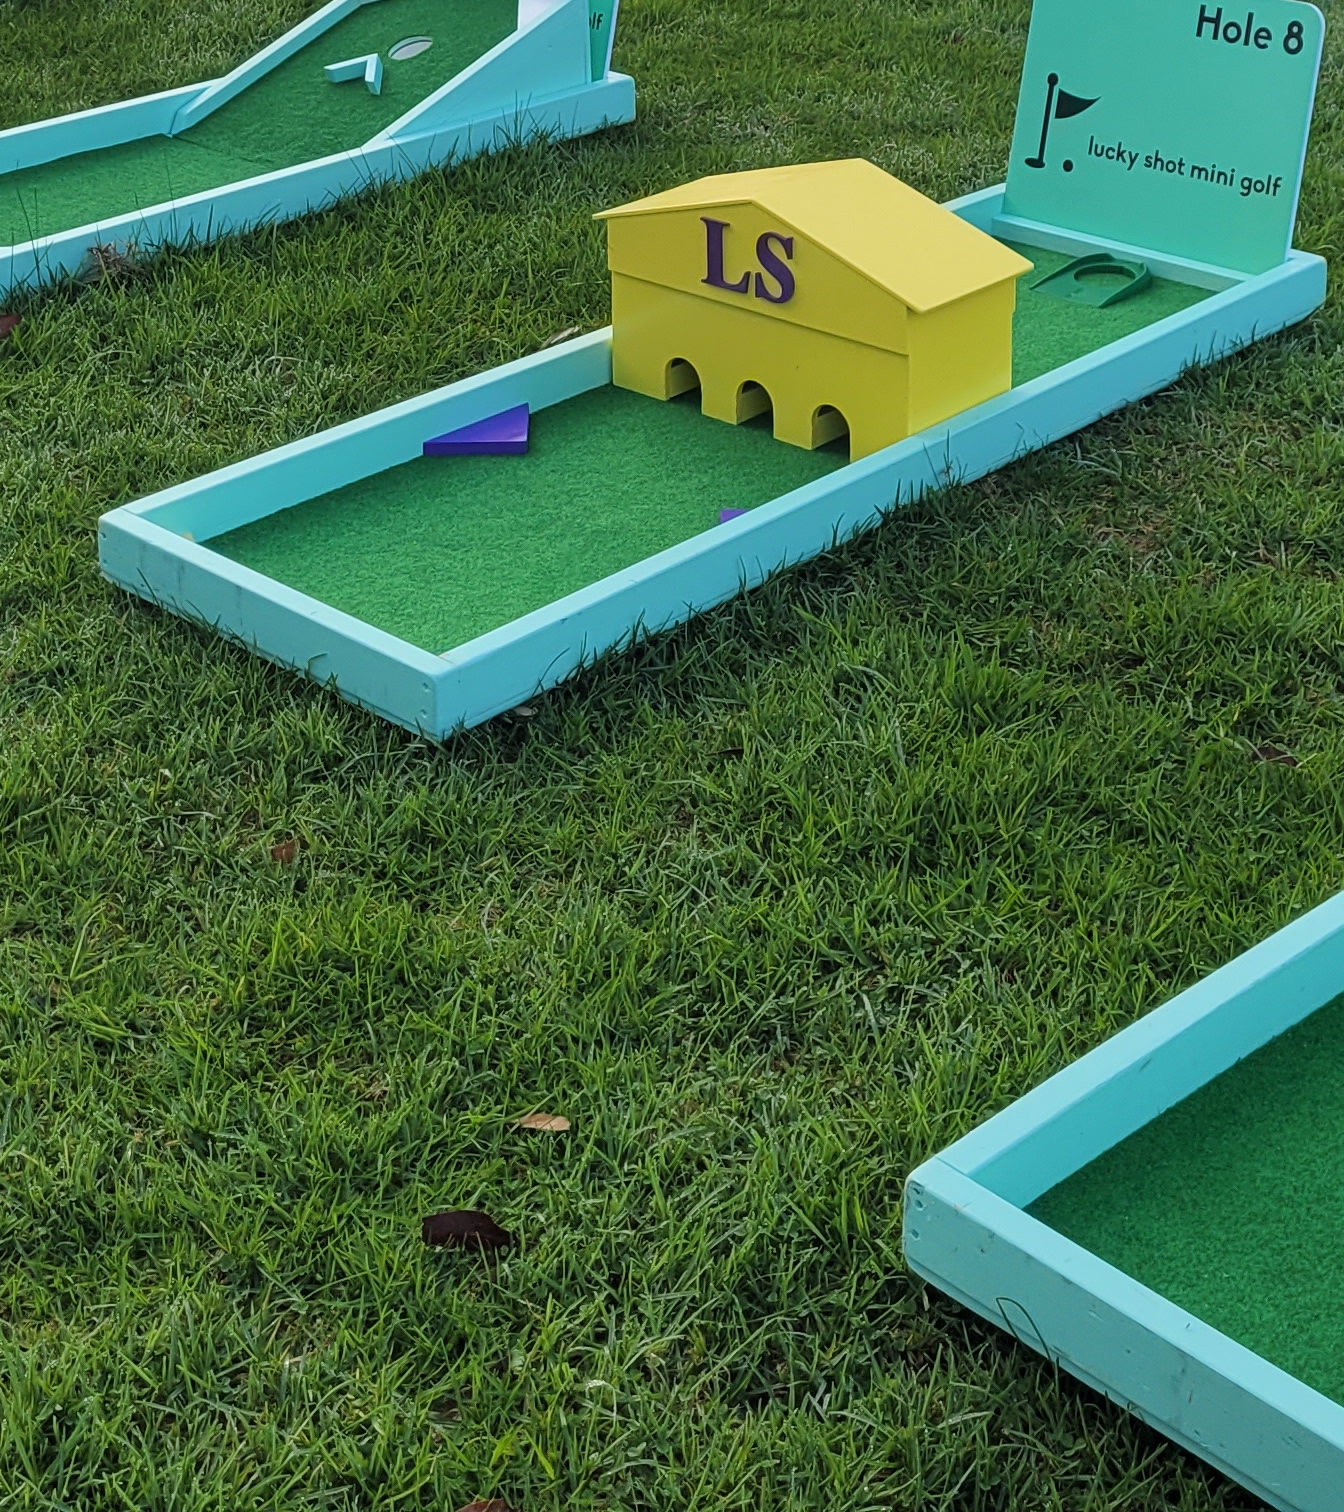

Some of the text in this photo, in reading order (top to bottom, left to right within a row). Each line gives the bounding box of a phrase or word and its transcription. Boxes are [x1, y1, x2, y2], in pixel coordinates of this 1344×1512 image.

[1195, 4, 1304, 55] Hole 8
[1087, 135, 1282, 197] lucky shot mini golf
[699, 216, 796, 305] LS
